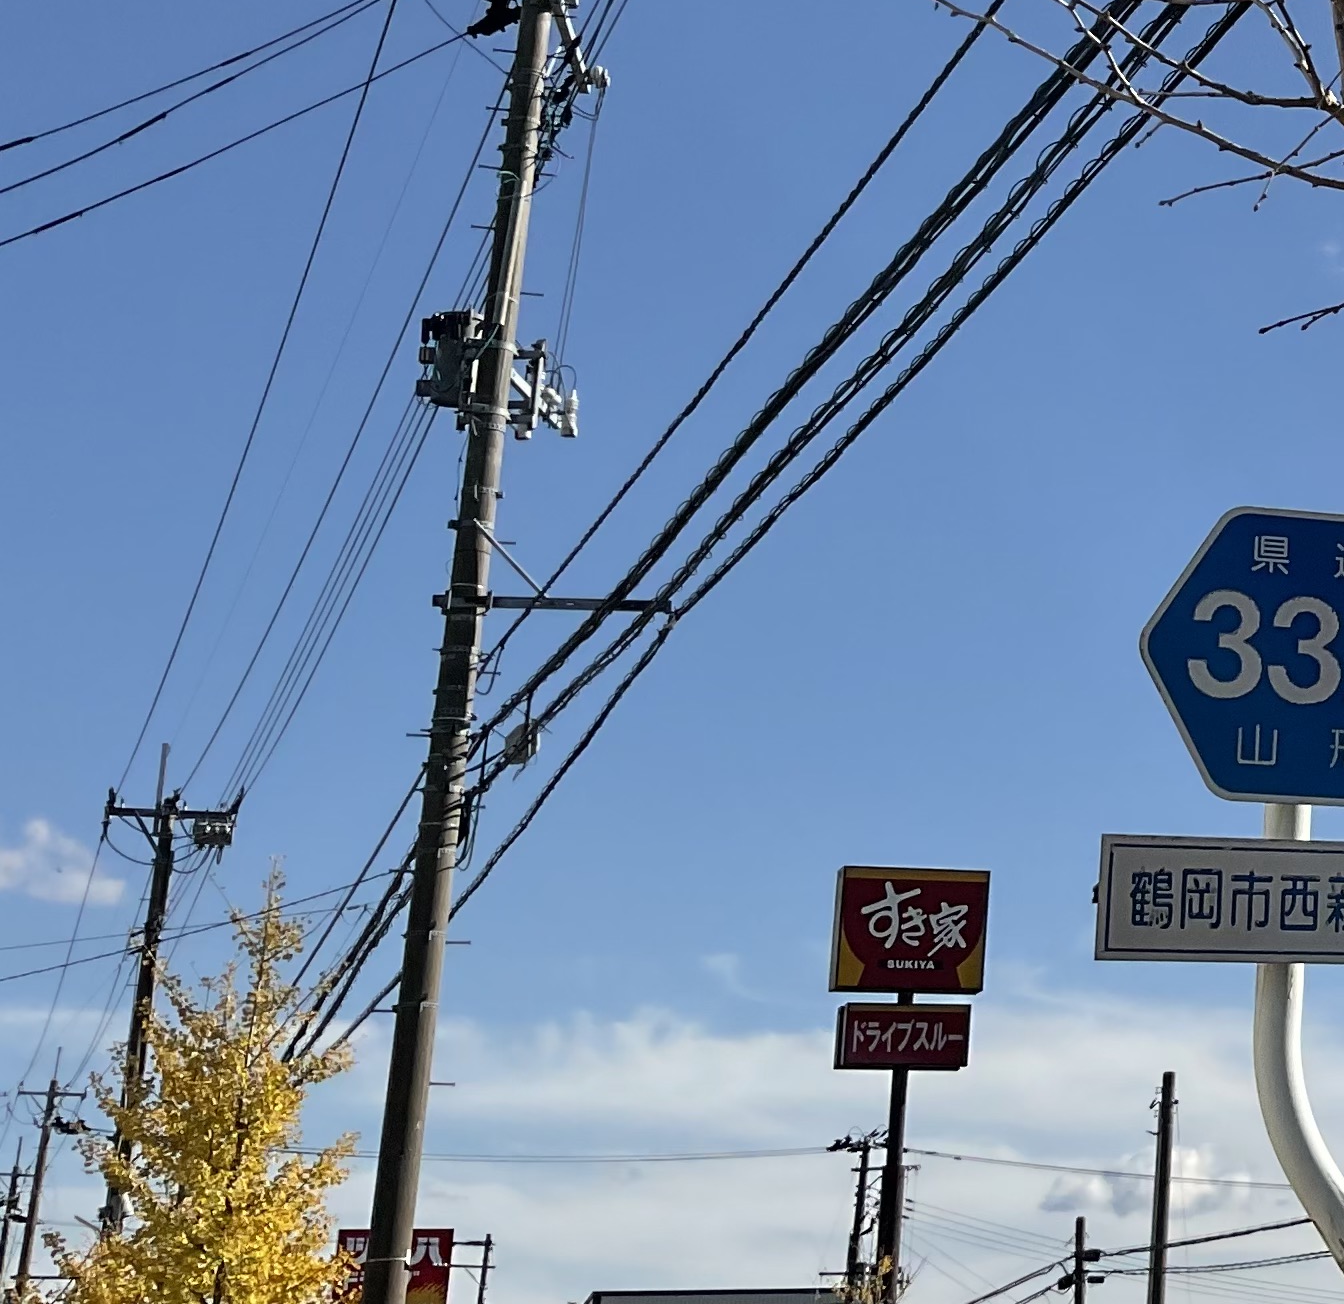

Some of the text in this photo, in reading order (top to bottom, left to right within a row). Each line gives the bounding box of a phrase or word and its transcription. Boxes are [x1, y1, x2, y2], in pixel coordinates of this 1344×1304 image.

[861, 881, 969, 957] すき家
[887, 960, 935, 970] SUKIYA
[852, 1019, 964, 1053] ドライブスルー
